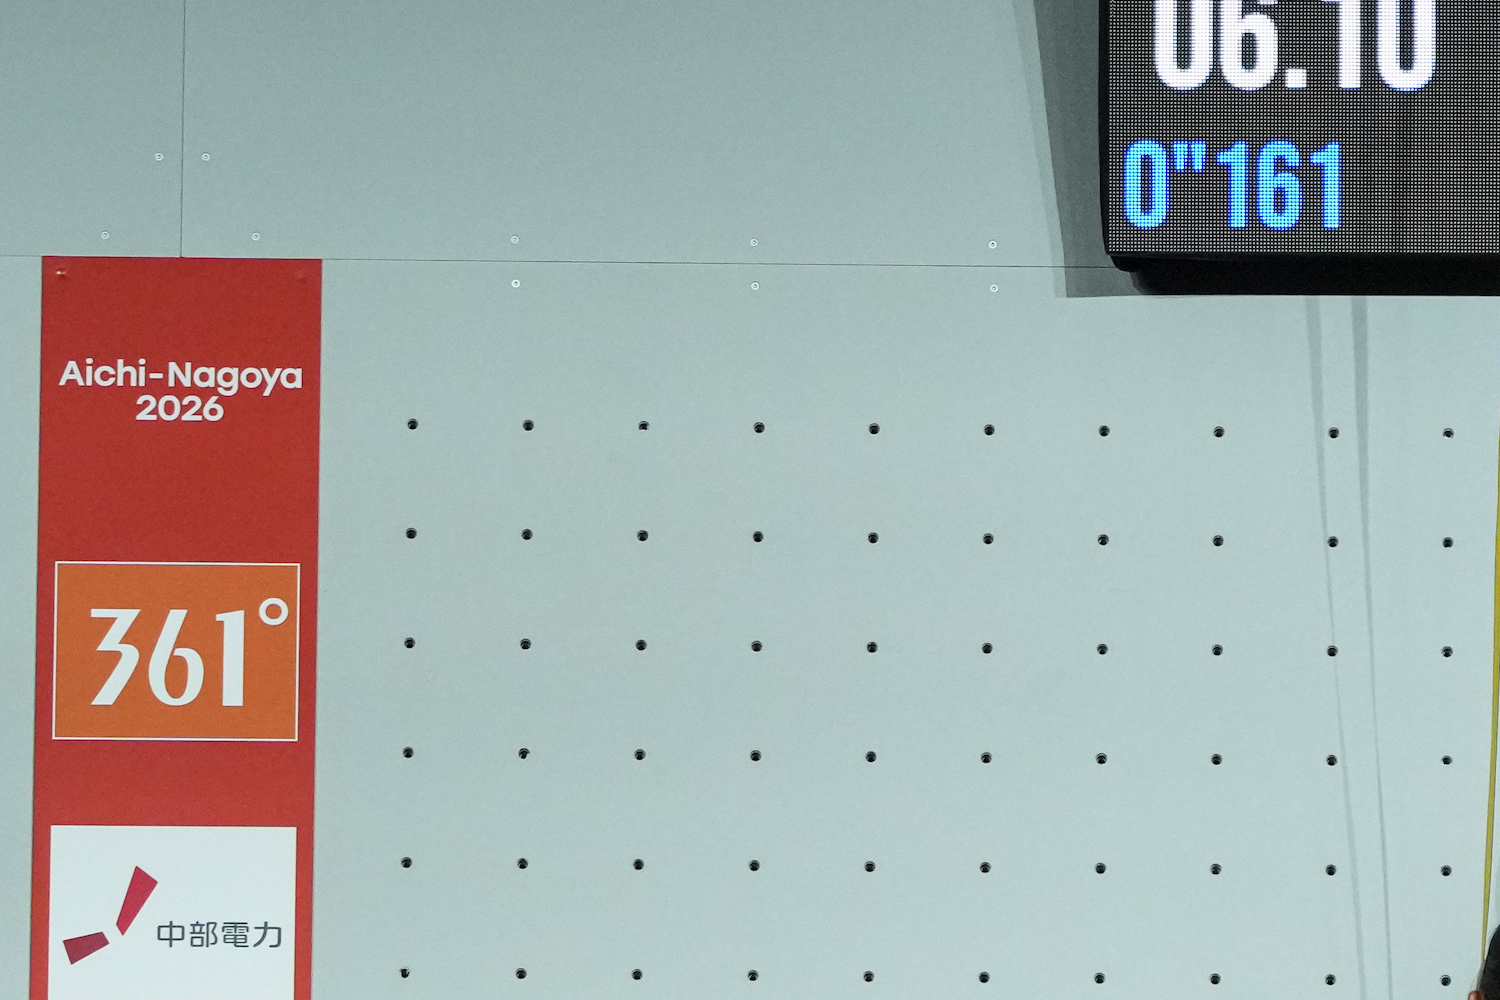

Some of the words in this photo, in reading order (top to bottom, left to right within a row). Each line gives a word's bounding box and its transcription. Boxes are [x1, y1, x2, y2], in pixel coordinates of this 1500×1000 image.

[1153, 0, 1437, 91] 06.10
[59, 358, 303, 396] Aichi-Nagoya
[135, 394, 224, 422] 2026
[156, 920, 282, 948] 中部電力
